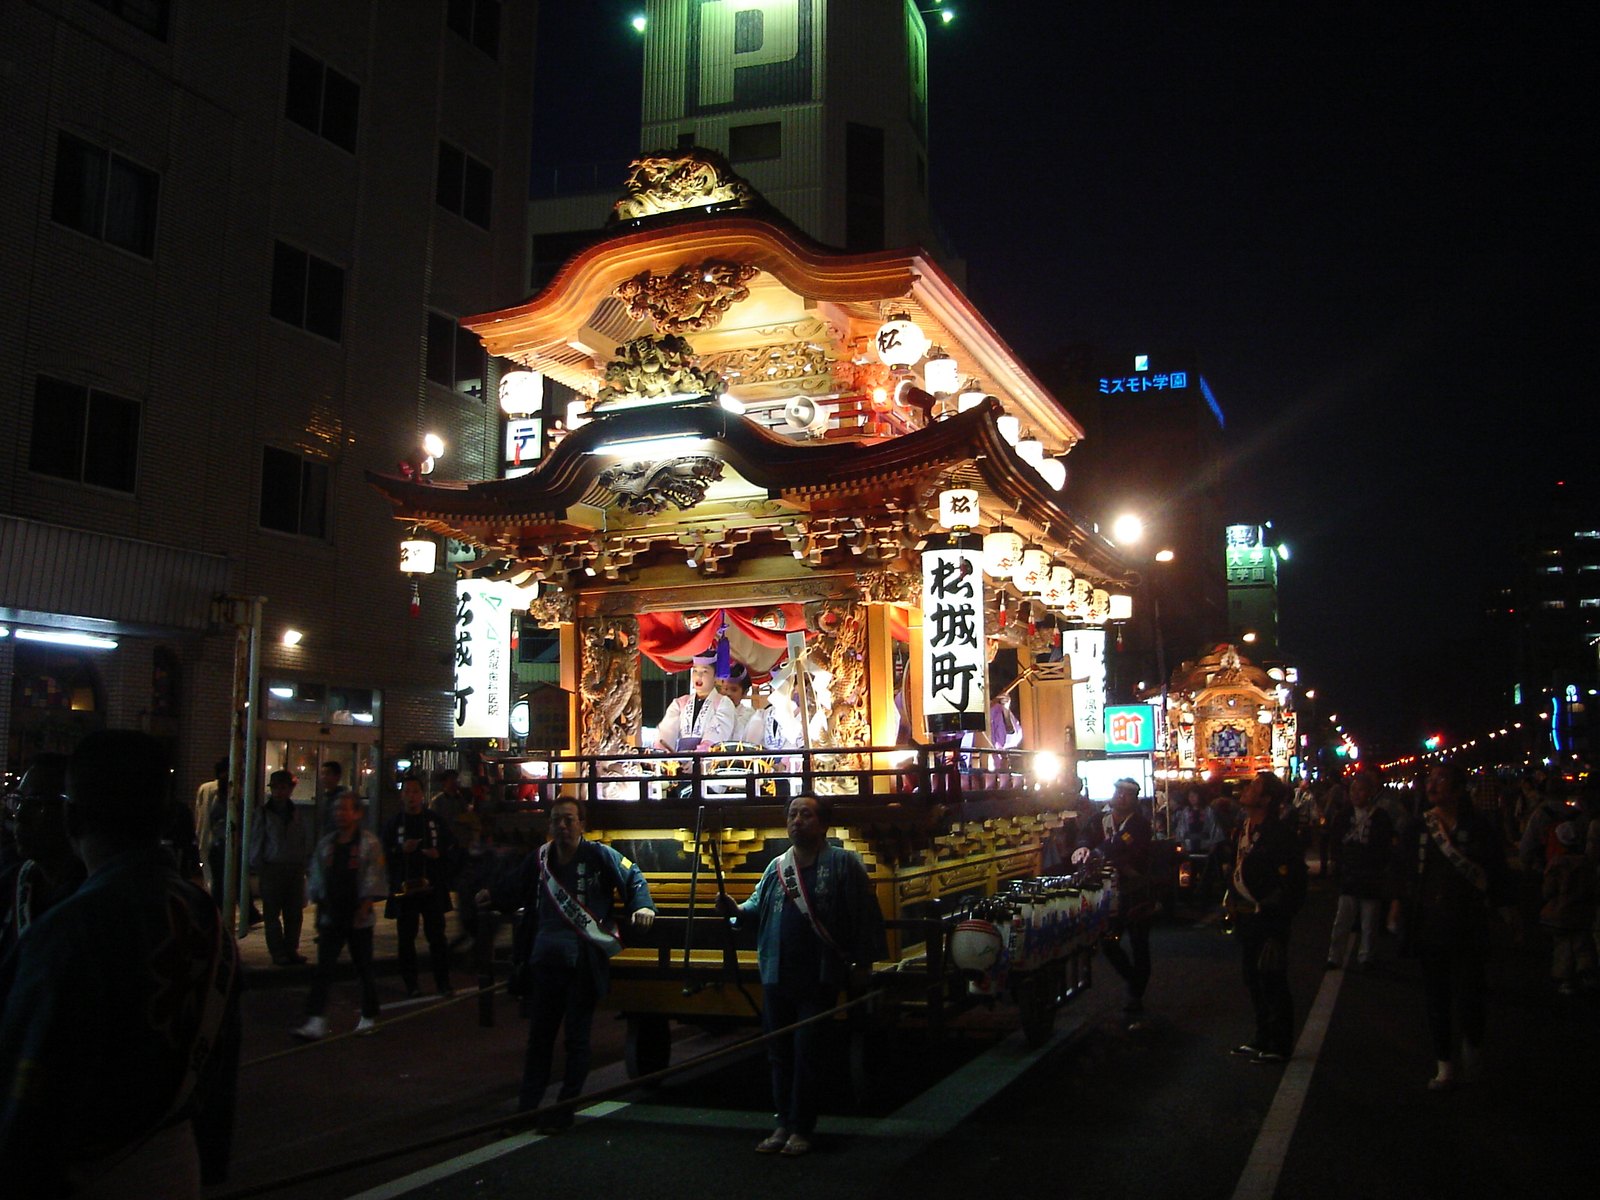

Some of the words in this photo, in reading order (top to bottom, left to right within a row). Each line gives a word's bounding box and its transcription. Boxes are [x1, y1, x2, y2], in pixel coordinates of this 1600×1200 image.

[1099, 371, 1187, 394] ミズモト学園
[950, 496, 971, 514] 松
[931, 557, 978, 713] 松城町
[1112, 715, 1142, 745] 町
